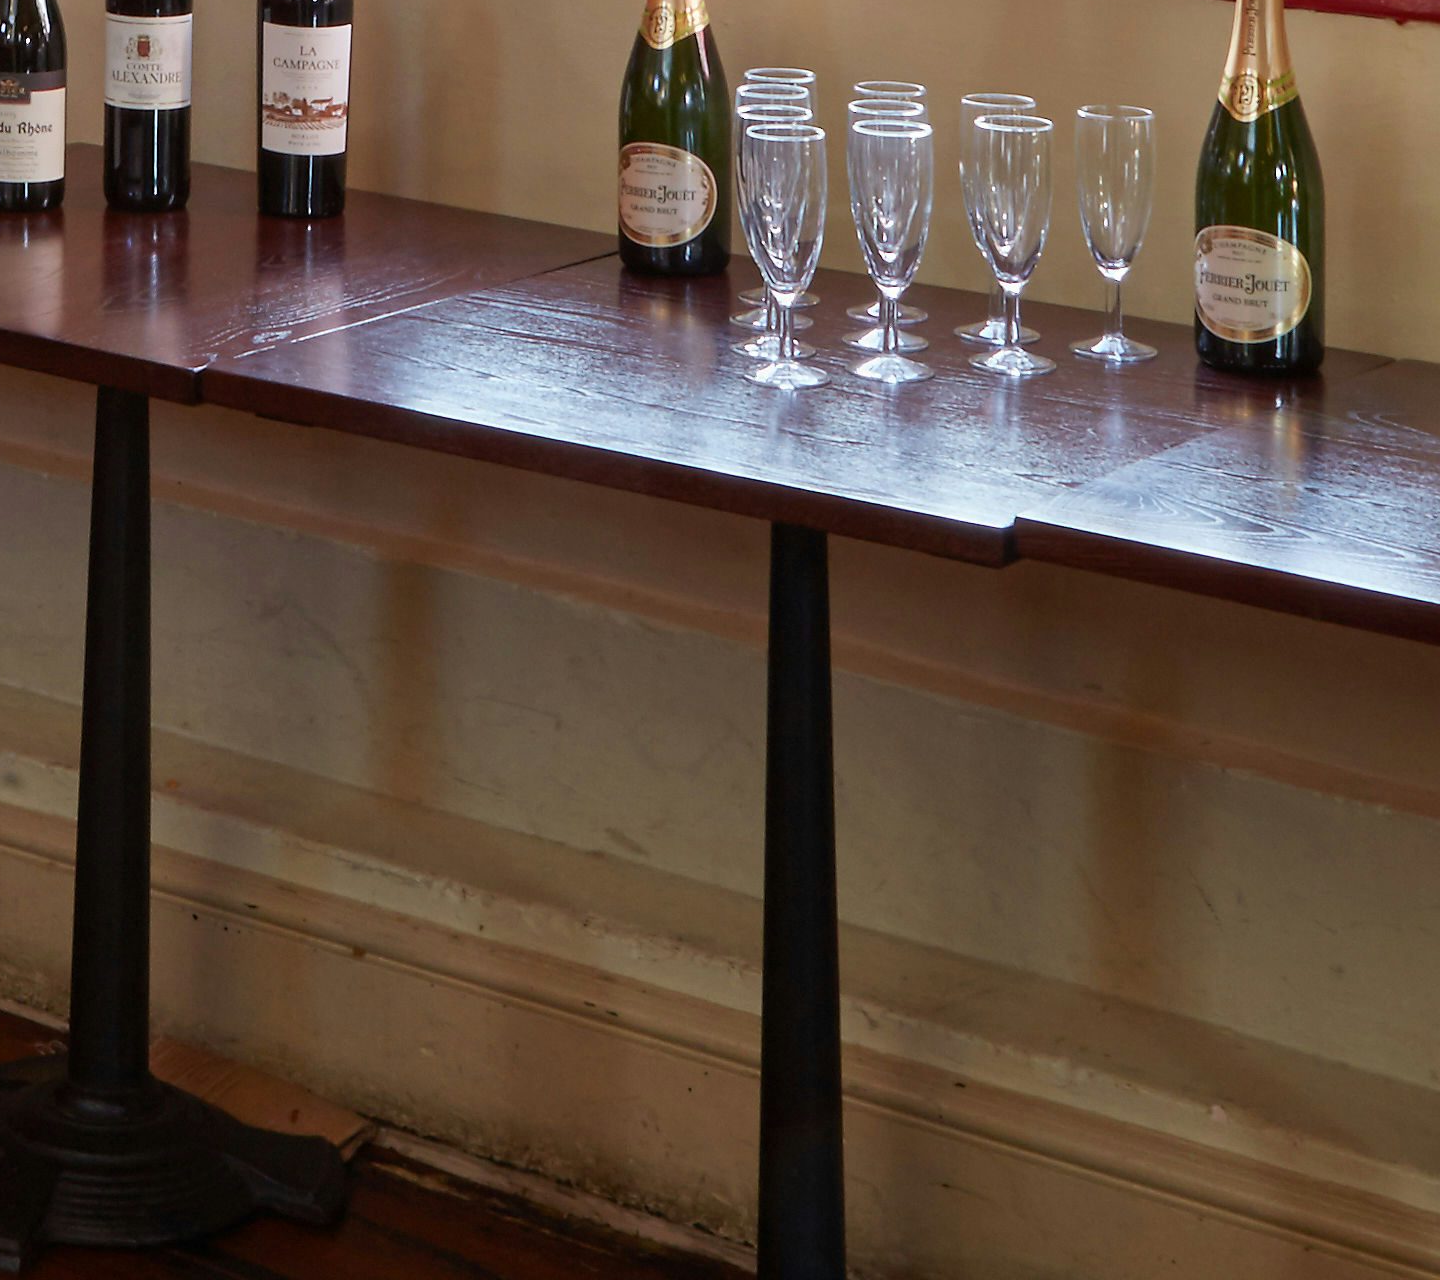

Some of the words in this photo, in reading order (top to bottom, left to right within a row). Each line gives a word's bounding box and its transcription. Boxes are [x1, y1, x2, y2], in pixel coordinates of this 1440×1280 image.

[300, 45, 317, 56] LA
[273, 57, 339, 70] CAMPAGNE
[112, 70, 181, 84] ALEXANDRE
